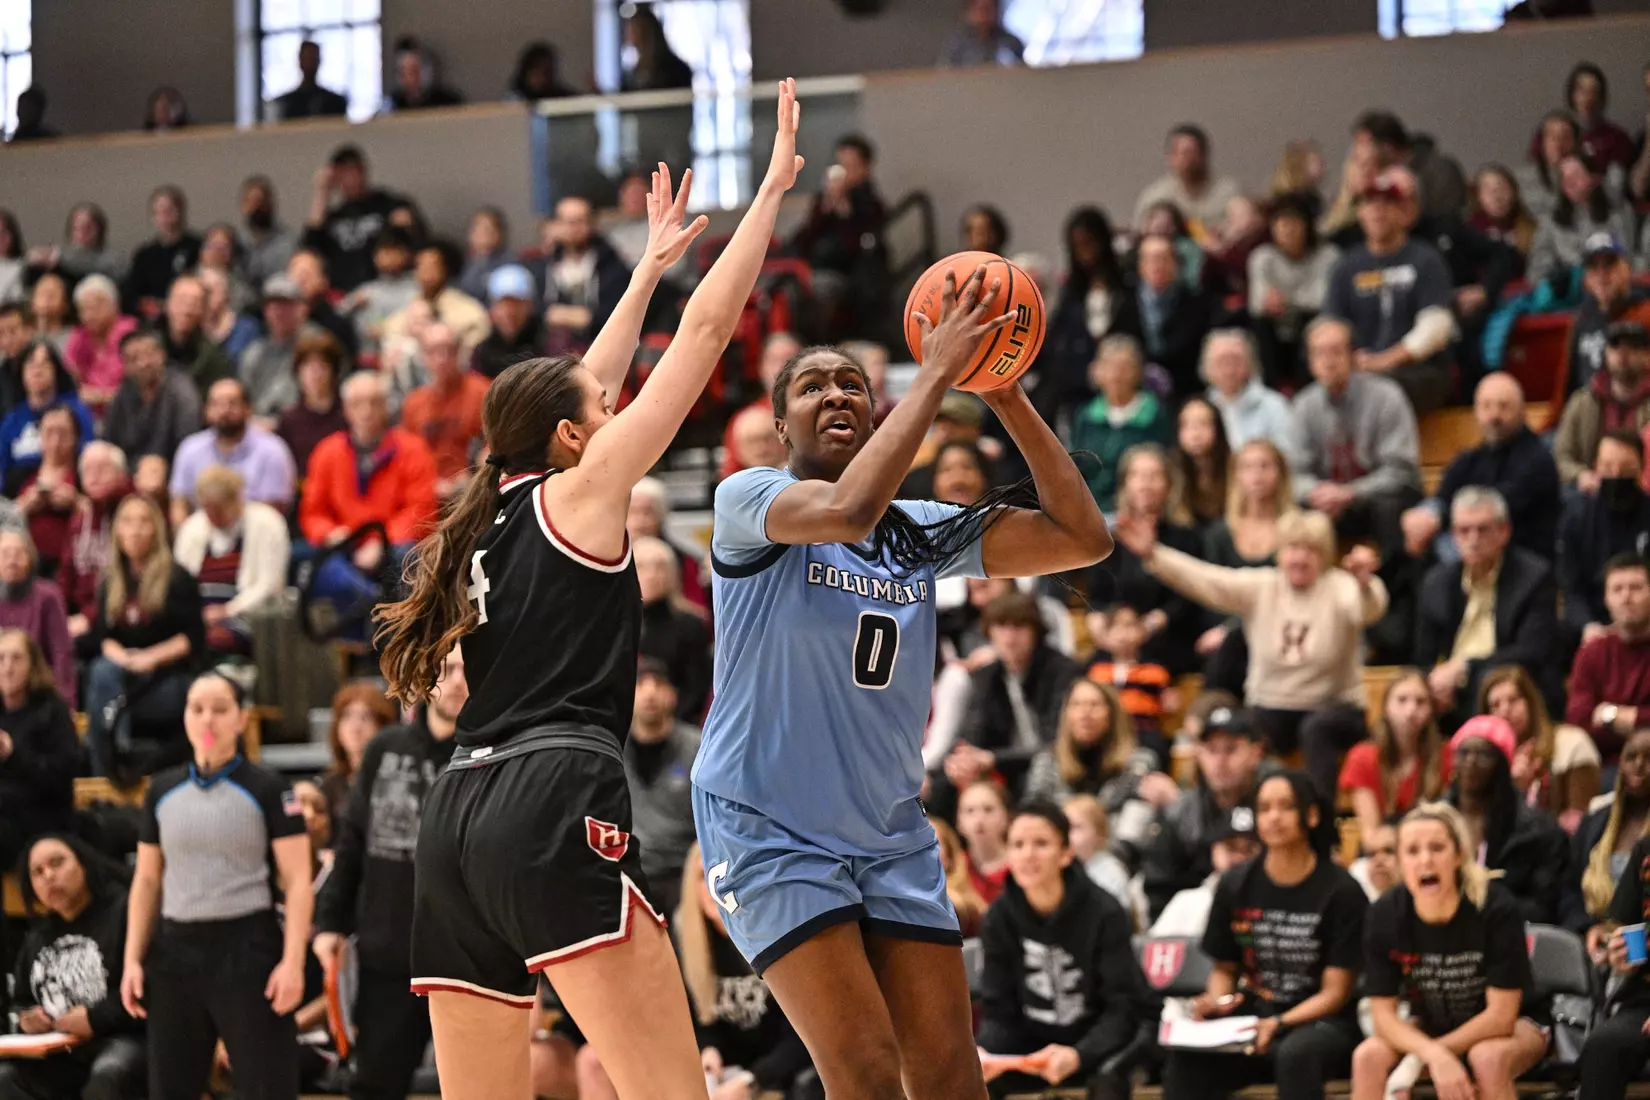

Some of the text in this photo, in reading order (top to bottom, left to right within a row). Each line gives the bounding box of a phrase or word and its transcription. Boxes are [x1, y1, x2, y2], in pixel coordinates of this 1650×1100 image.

[987, 303, 1032, 376] ELITE
[467, 549, 491, 626] 4
[806, 561, 929, 606] COLUMBIA
[852, 610, 900, 690] 0
[595, 824, 621, 849] H
[707, 859, 742, 915] C
[1148, 941, 1177, 977] H
